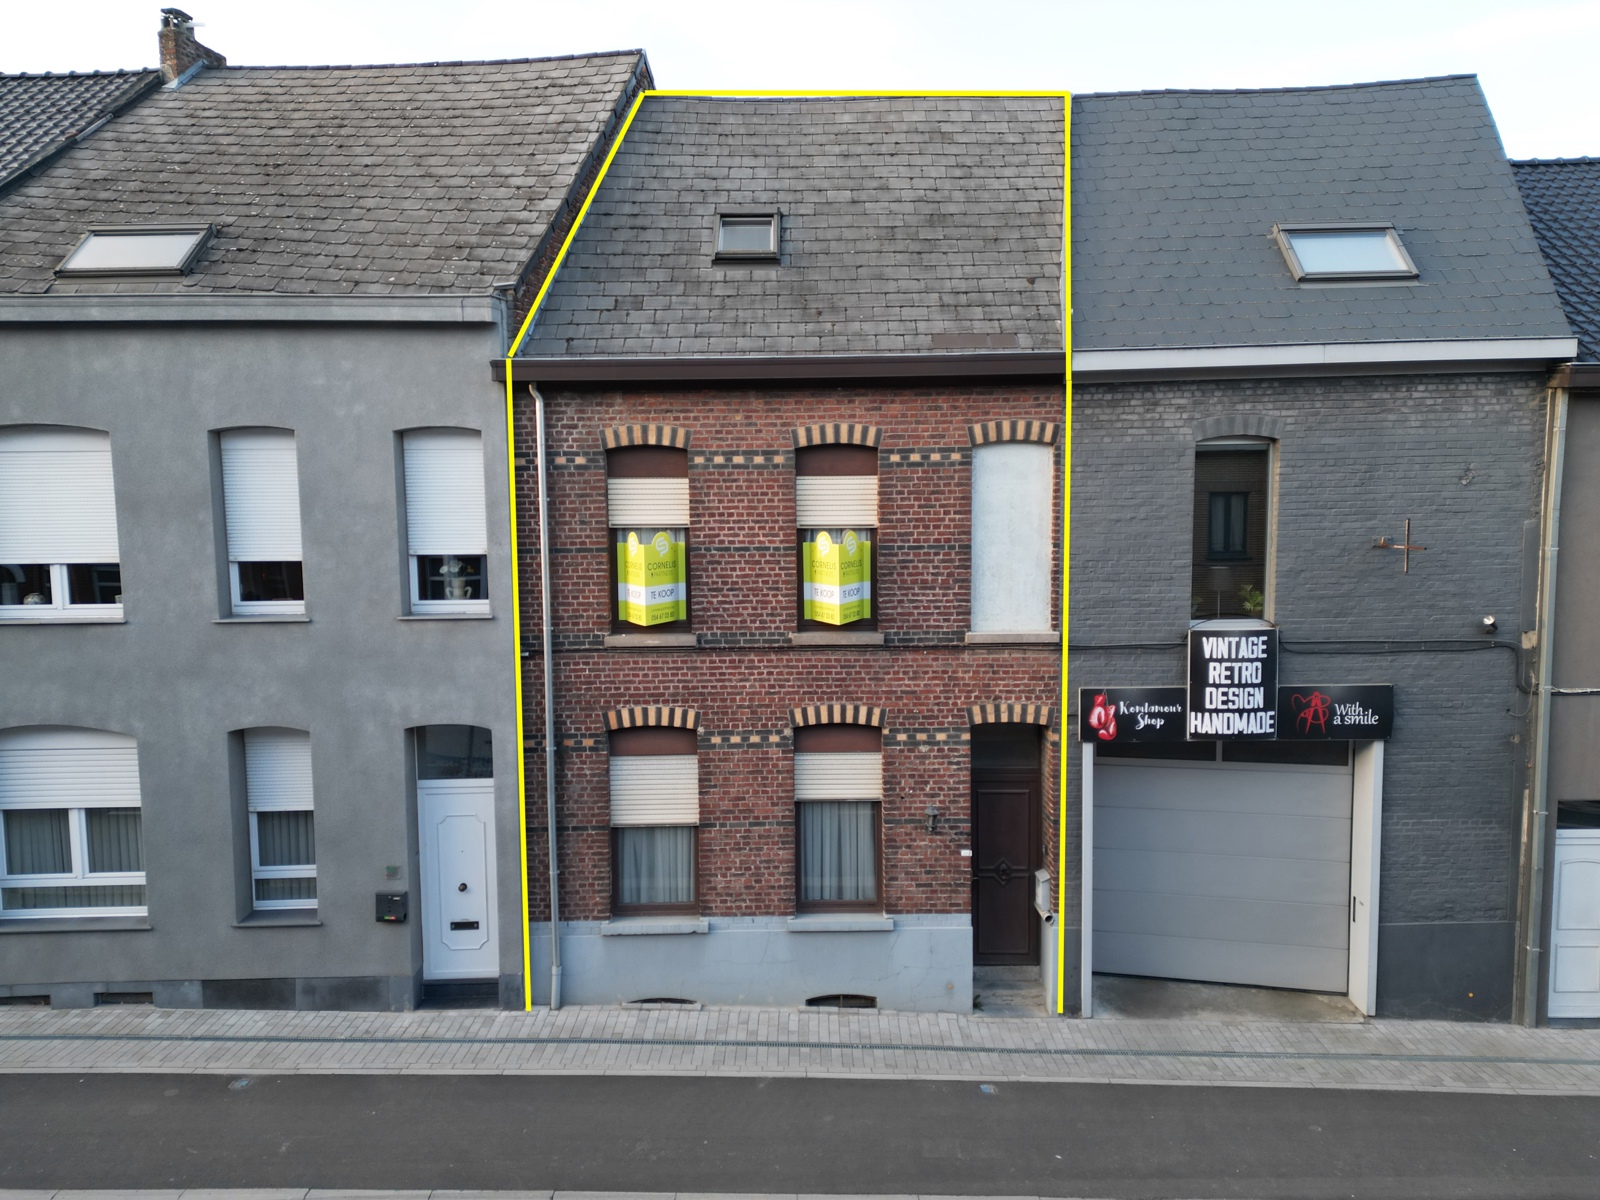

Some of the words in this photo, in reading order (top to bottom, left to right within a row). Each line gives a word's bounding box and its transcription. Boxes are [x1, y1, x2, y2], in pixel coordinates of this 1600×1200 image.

[647, 561, 676, 571] CORNELIS
[811, 560, 836, 570] CORNELIS
[840, 560, 862, 570] CORNELIS
[651, 591, 657, 600] TE
[658, 588, 675, 599] KOOP
[814, 588, 819, 597] TE
[820, 589, 835, 599] KOOP
[847, 587, 860, 597] KOOP
[1202, 636, 1268, 659] VINTAGE
[1208, 661, 1262, 684] RETRO
[1205, 686, 1264, 709] DESIGN
[1334, 702, 1364, 715] With
[1135, 712, 1165, 730] Shop
[1190, 711, 1275, 734] HANDMADE
[1333, 715, 1342, 725] a
[1344, 709, 1379, 725] smile
